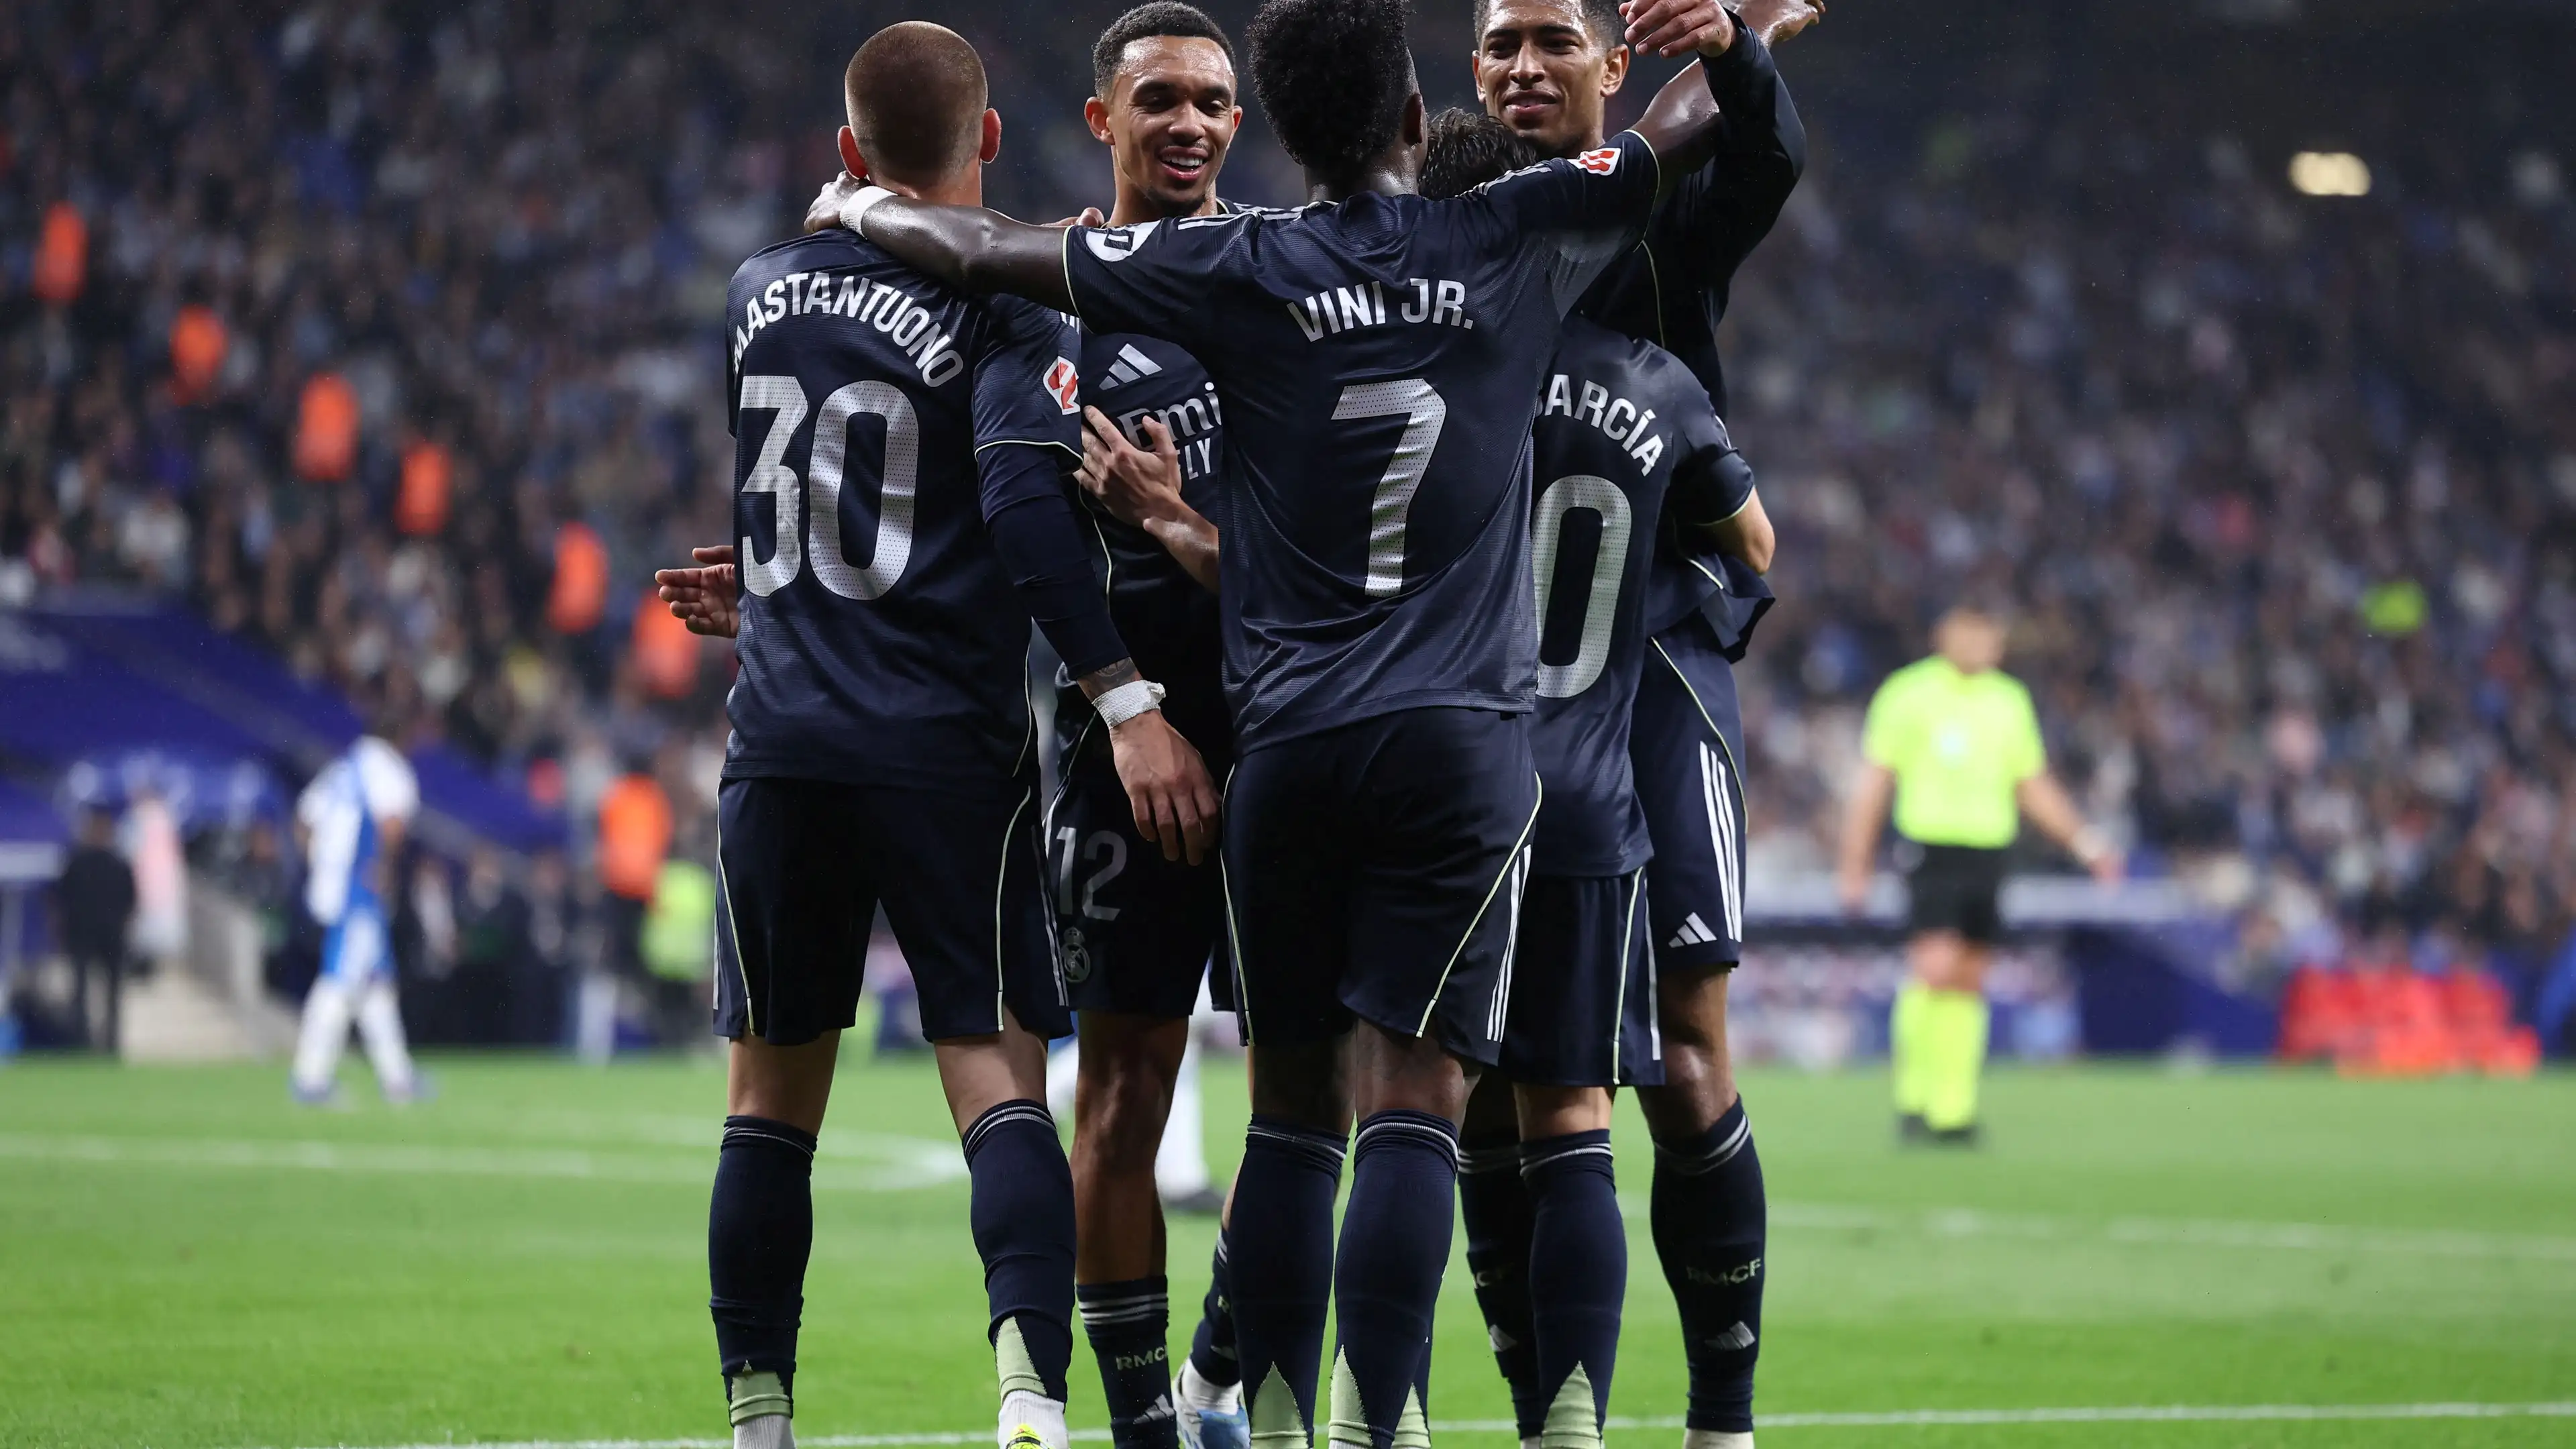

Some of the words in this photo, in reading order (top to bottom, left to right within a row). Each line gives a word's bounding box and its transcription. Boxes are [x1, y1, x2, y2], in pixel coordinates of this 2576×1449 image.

[733, 272, 963, 388] MASTANTUONO
[1287, 280, 1386, 343] VINI
[1401, 278, 1474, 330] JR.
[1175, 437, 1212, 480] LY
[1535, 374, 1664, 477] ARCÍA
[739, 375, 920, 600] 30
[1331, 378, 1446, 598] 7
[1055, 826, 1128, 922] 12
[1114, 1344, 1168, 1371] RMC
